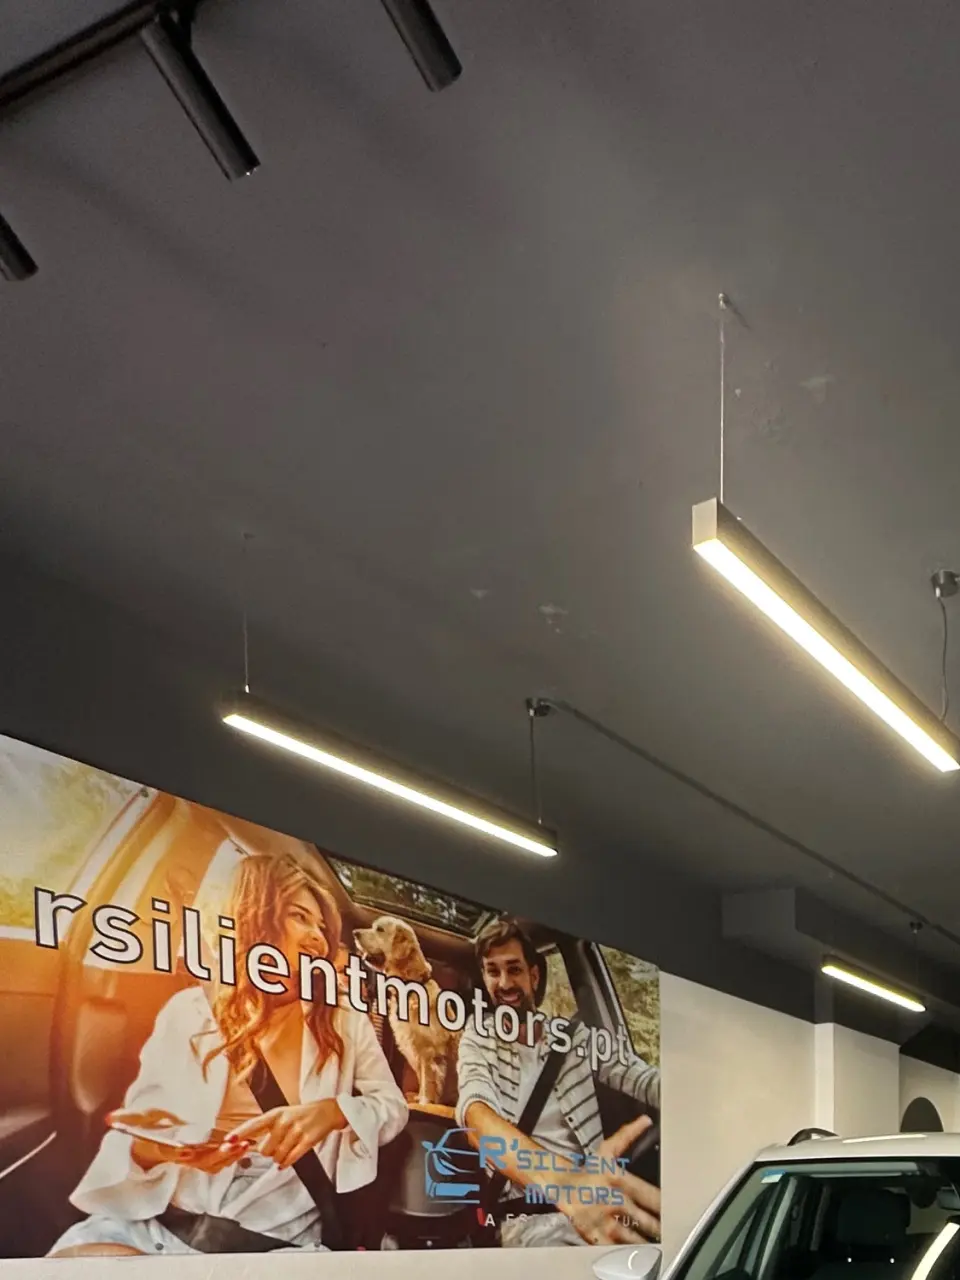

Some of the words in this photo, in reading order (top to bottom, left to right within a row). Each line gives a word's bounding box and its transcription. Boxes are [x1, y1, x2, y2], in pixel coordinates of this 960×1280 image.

[34, 886, 630, 1071] rsilientmotors.pt
[479, 1135, 630, 1176] R'SILIENT
[524, 1183, 625, 1206] MOTORS
[484, 1213, 496, 1228] A
